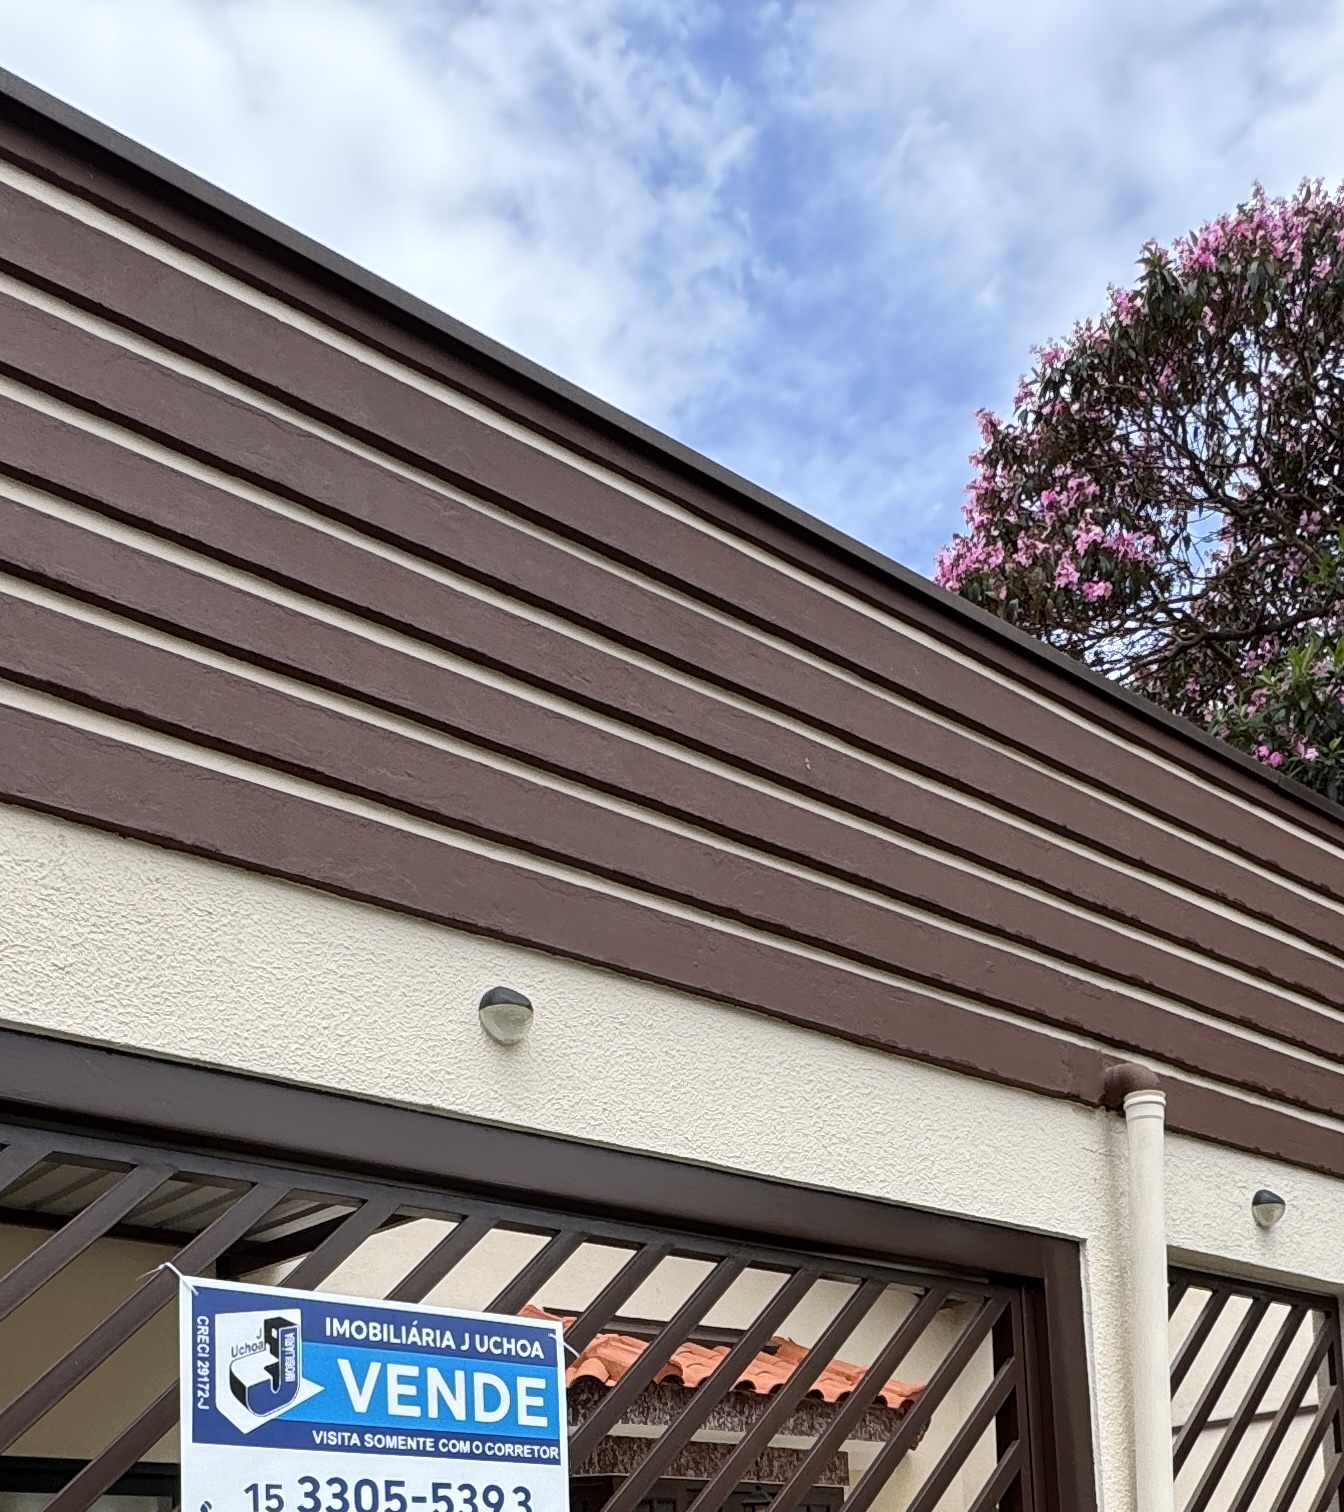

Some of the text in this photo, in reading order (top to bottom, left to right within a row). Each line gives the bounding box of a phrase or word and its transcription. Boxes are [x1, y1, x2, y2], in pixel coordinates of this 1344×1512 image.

[230, 1340, 265, 1358] Uchoa
[255, 1327, 262, 1340] J
[325, 1317, 545, 1359] IMOBILIÁRIA J UCHOA
[196, 1315, 210, 1410] CRECI 29172-J
[337, 1358, 549, 1427] VENDE
[311, 1430, 560, 1460] VISITA SOMENTE COM O CORRETOR
